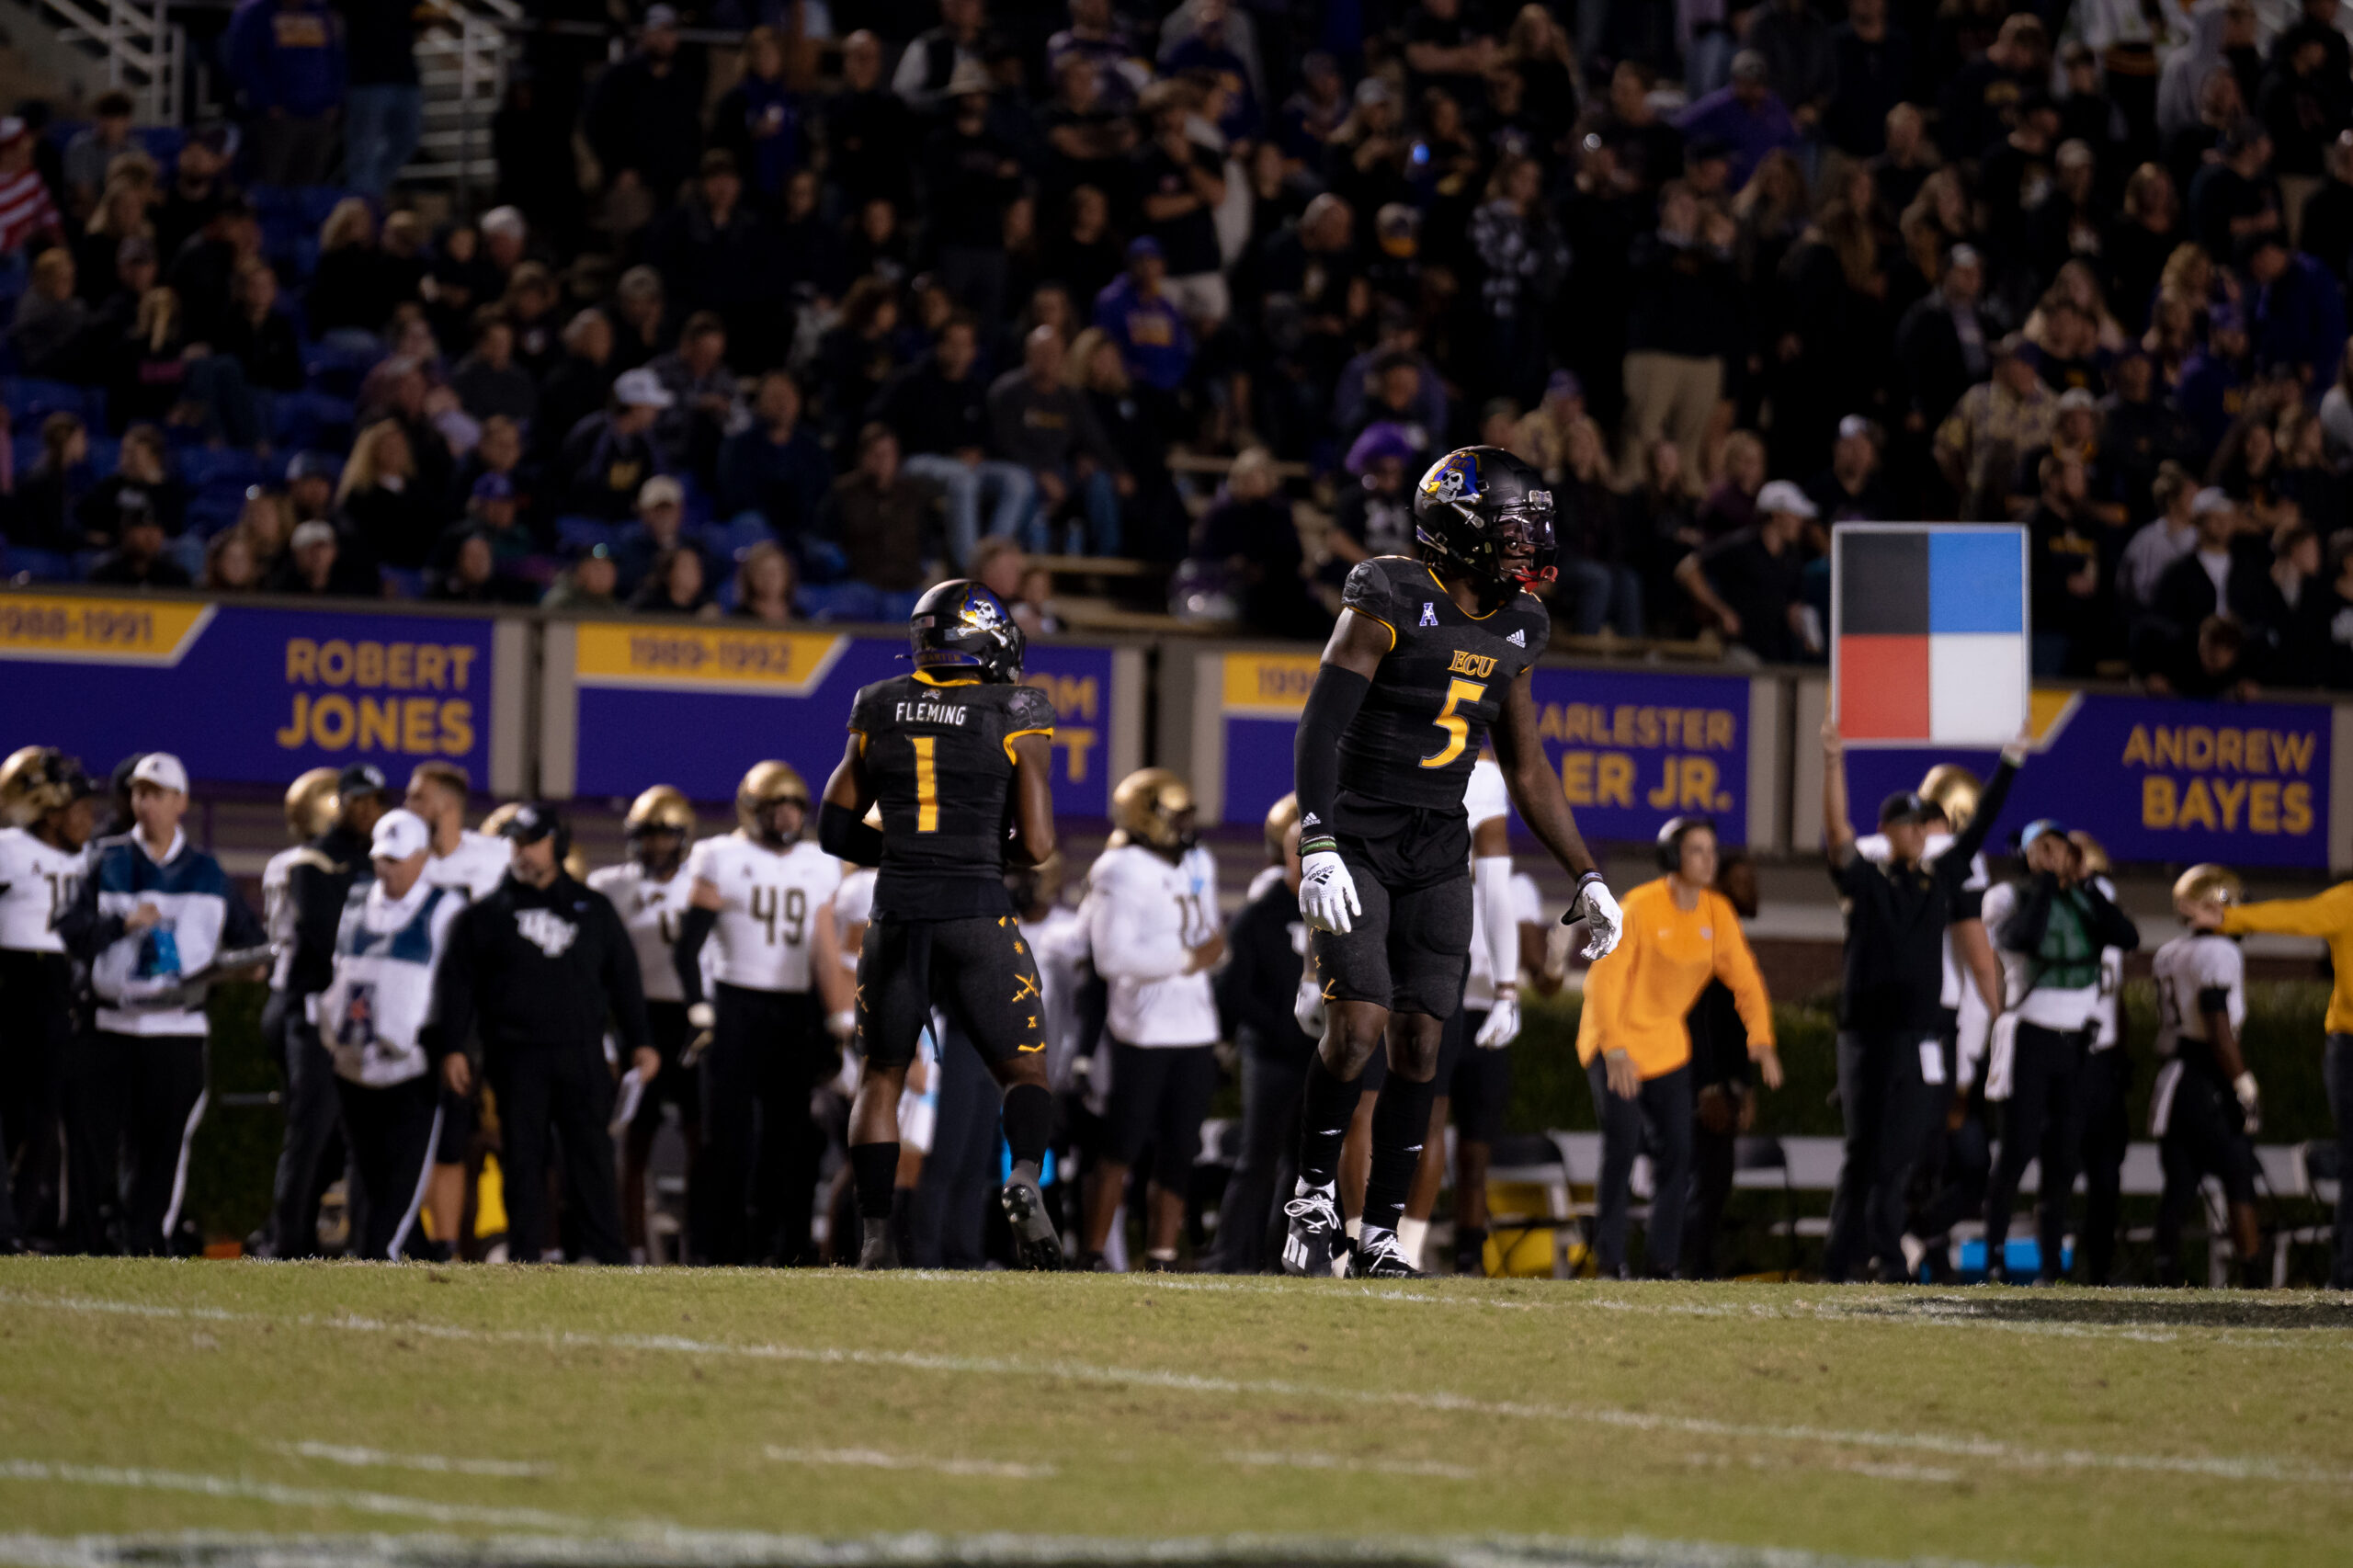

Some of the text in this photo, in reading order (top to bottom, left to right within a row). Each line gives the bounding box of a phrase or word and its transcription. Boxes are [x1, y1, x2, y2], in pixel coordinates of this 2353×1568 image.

[286, 638, 476, 689] ROBERT
[1448, 650, 1498, 678] ECU
[277, 693, 474, 756] JONES
[894, 701, 966, 726] FLEMING
[1418, 676, 1488, 767] 5
[1539, 702, 1733, 751] ARLESTER
[2122, 723, 2315, 774] ANDREW
[905, 735, 938, 833] 1
[1648, 755, 1733, 812] JR.
[2143, 776, 2313, 835] BAYES
[750, 886, 806, 947] 49
